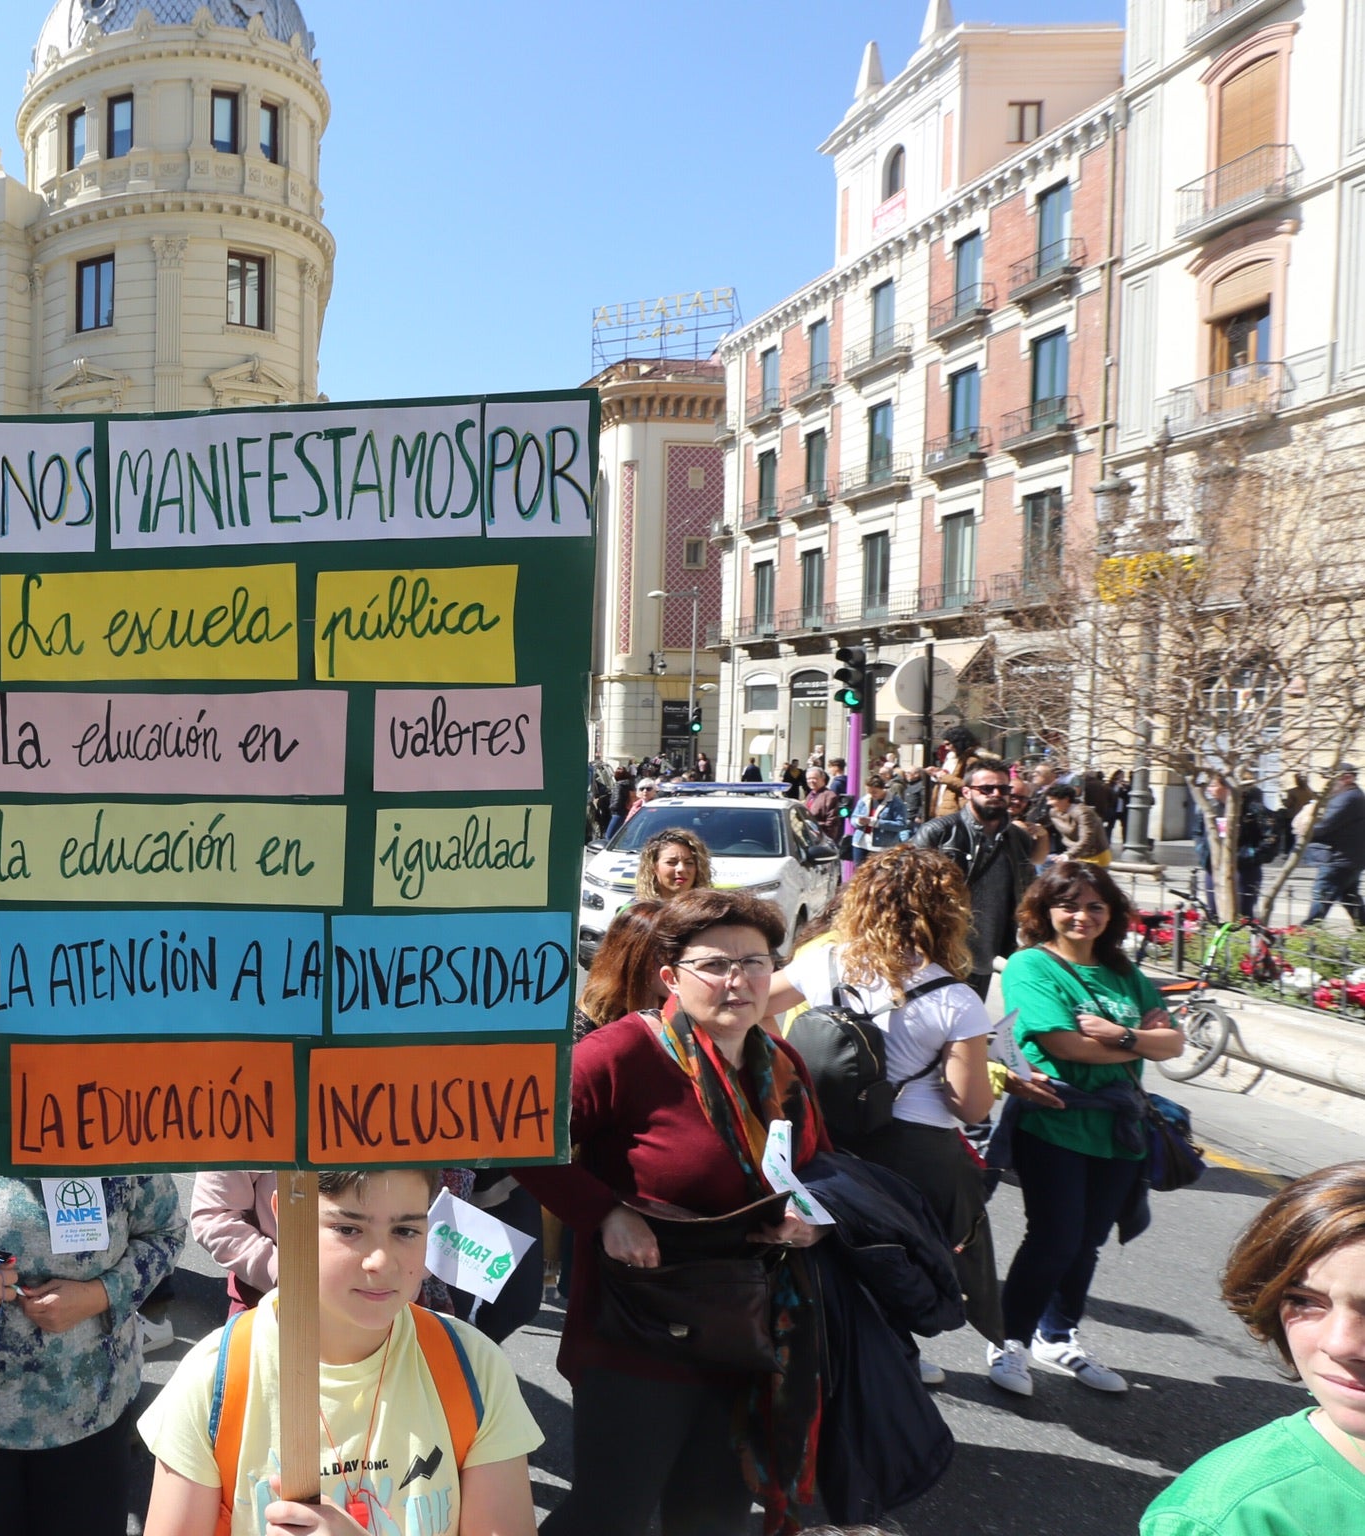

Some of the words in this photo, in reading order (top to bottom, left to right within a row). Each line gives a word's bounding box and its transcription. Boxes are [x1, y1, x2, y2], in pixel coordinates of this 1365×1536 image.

[0, 446, 92, 538] NOS
[114, 418, 480, 535] MANIFESTAMOS
[487, 424, 592, 526] POR
[7, 574, 85, 659] La
[102, 587, 293, 657] escuela
[322, 575, 501, 679] pública
[72, 699, 223, 768] educación
[238, 720, 299, 763] en
[389, 695, 531, 760] valores
[59, 808, 237, 880] educación
[255, 835, 316, 878] en
[378, 807, 536, 900] igualdad
[48, 929, 218, 1008] ATENCIÓN
[231, 939, 267, 1007] A
[281, 937, 325, 1001] LA
[336, 940, 570, 1016] DIVERSIDAD
[18, 1071, 65, 1154] LA
[76, 1065, 275, 1152] EDUCACIÓN
[316, 1074, 550, 1151] INCLUSIVA
[56, 1207, 103, 1223] ANPE
[332, 1459, 359, 1475] DAY
[361, 1459, 389, 1470] LONG
